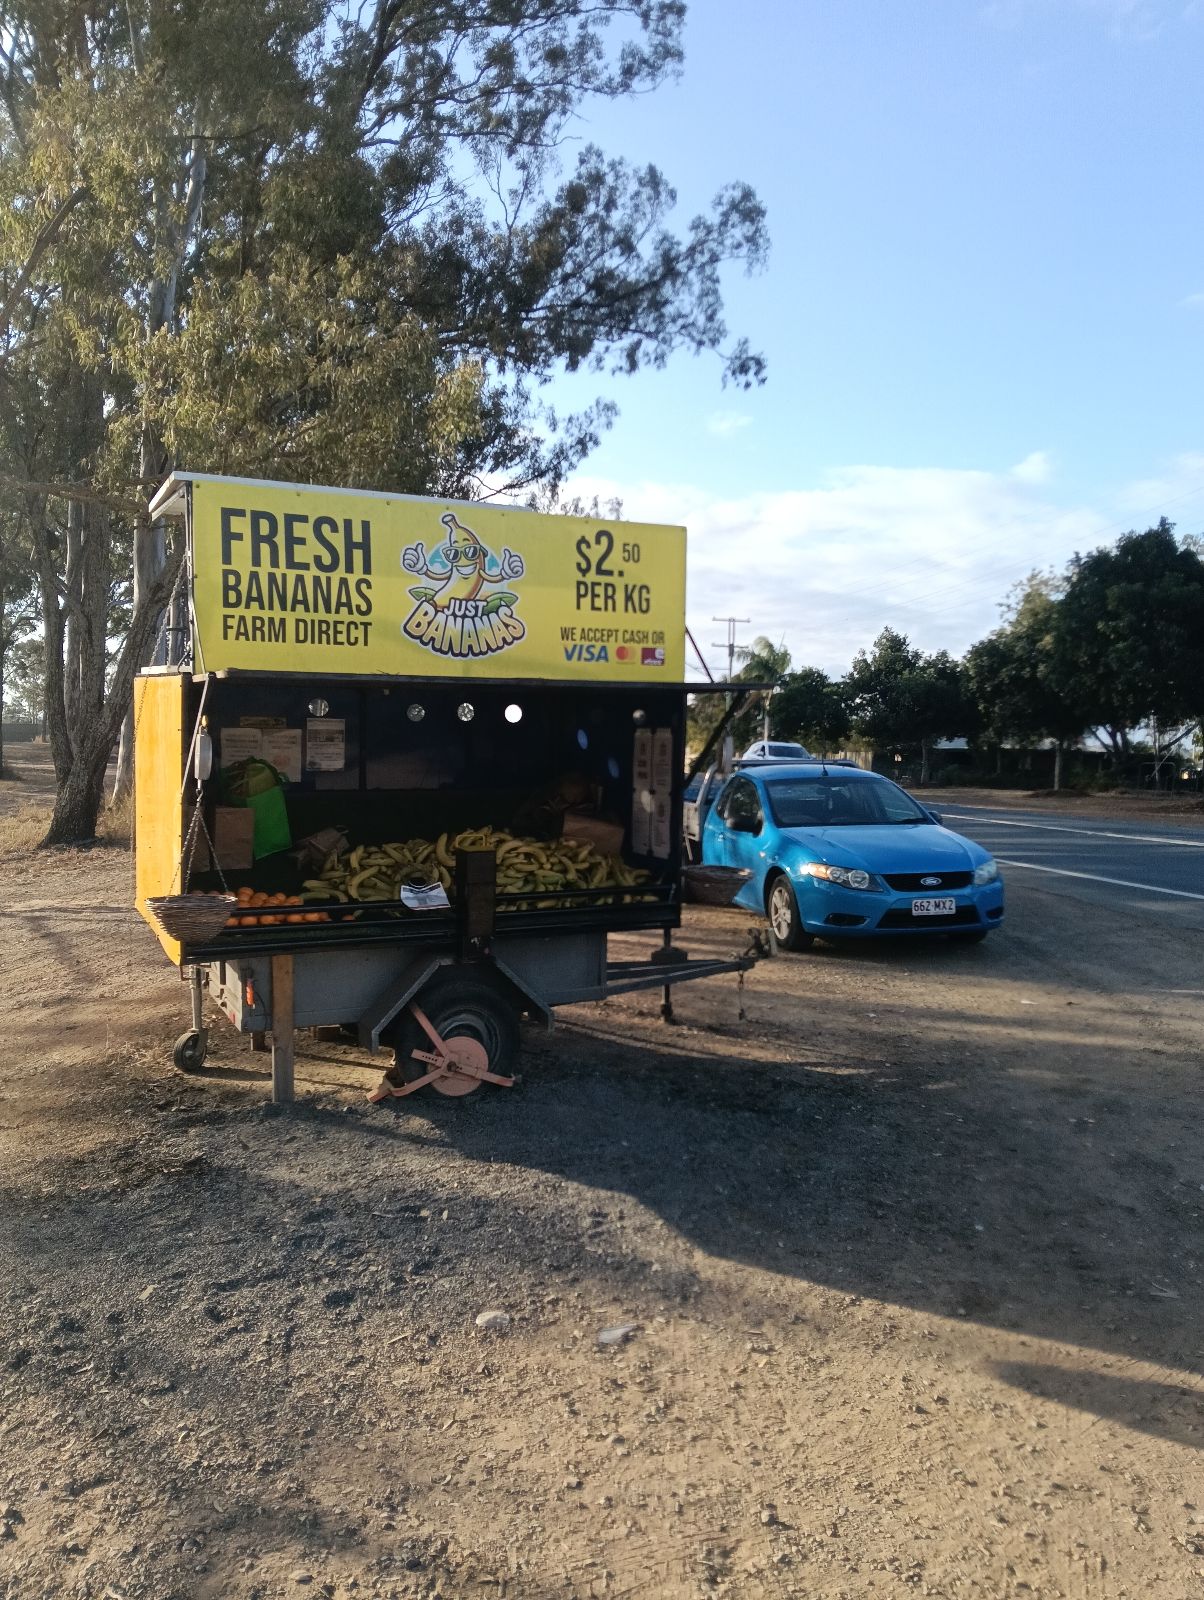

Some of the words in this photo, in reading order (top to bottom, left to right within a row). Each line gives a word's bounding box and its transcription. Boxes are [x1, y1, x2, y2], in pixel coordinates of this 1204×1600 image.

[220, 507, 373, 575] FRESH
[221, 568, 373, 617] BANANAS
[443, 598, 488, 617] JUST
[576, 580, 617, 613] PER
[623, 583, 651, 615] KG
[222, 614, 287, 643] FARM
[294, 618, 373, 647] DIRECT
[403, 599, 526, 657] BANANAS
[560, 626, 577, 642] WE
[579, 627, 620, 643] ACCEPT
[622, 629, 649, 644] CASH
[651, 631, 665, 644] OR
[564, 644, 609, 662] VISA
